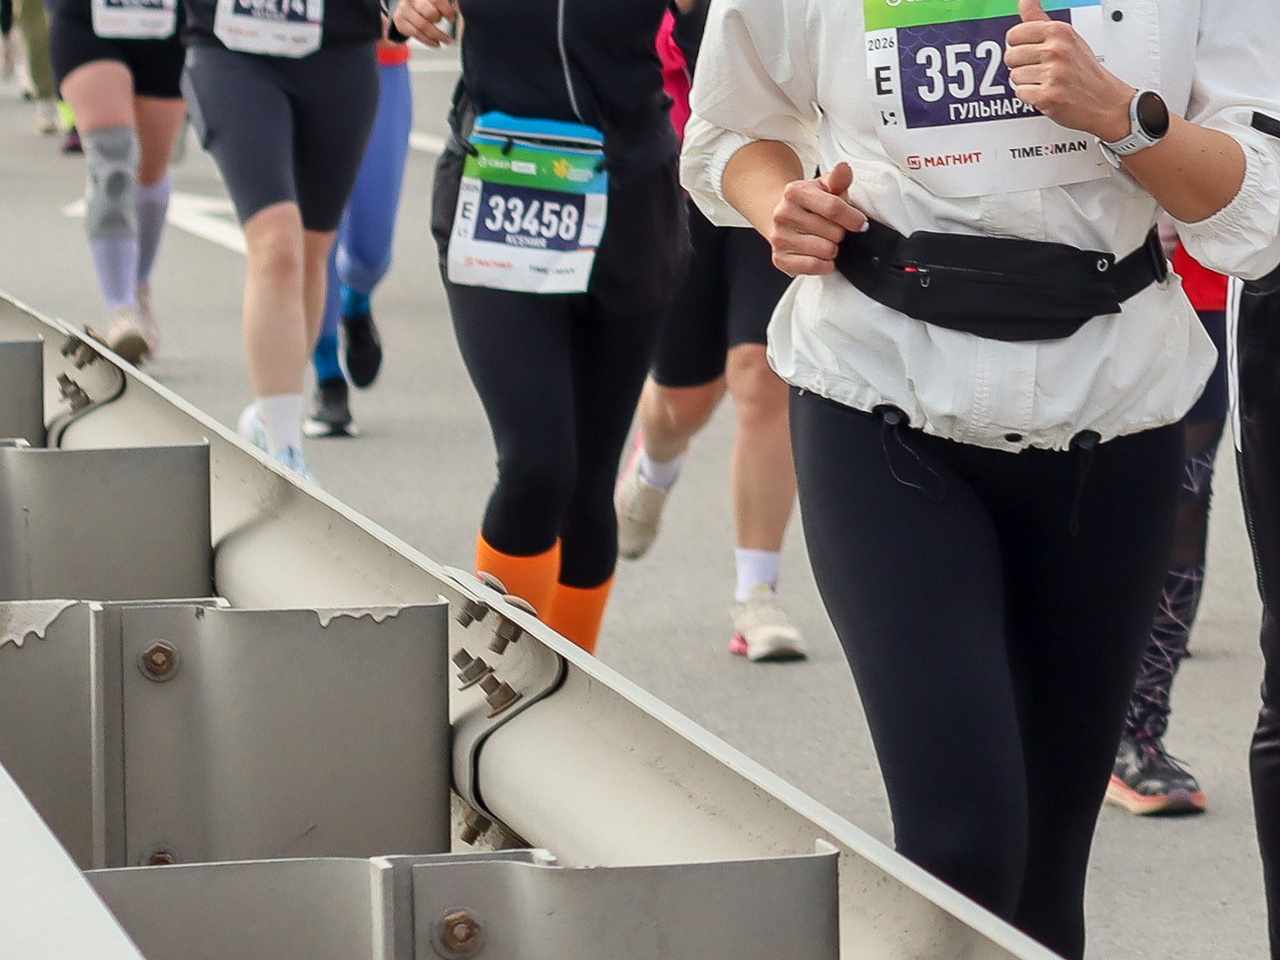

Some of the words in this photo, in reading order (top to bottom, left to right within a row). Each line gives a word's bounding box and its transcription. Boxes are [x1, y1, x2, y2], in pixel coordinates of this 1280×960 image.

[867, 37, 895, 51] 2026
[874, 65, 894, 96] E
[915, 40, 1017, 103] 352
[948, 97, 1036, 121] ГУЛЬНАРА
[924, 151, 982, 168] МАГНИТ
[484, 194, 579, 241] 33458
